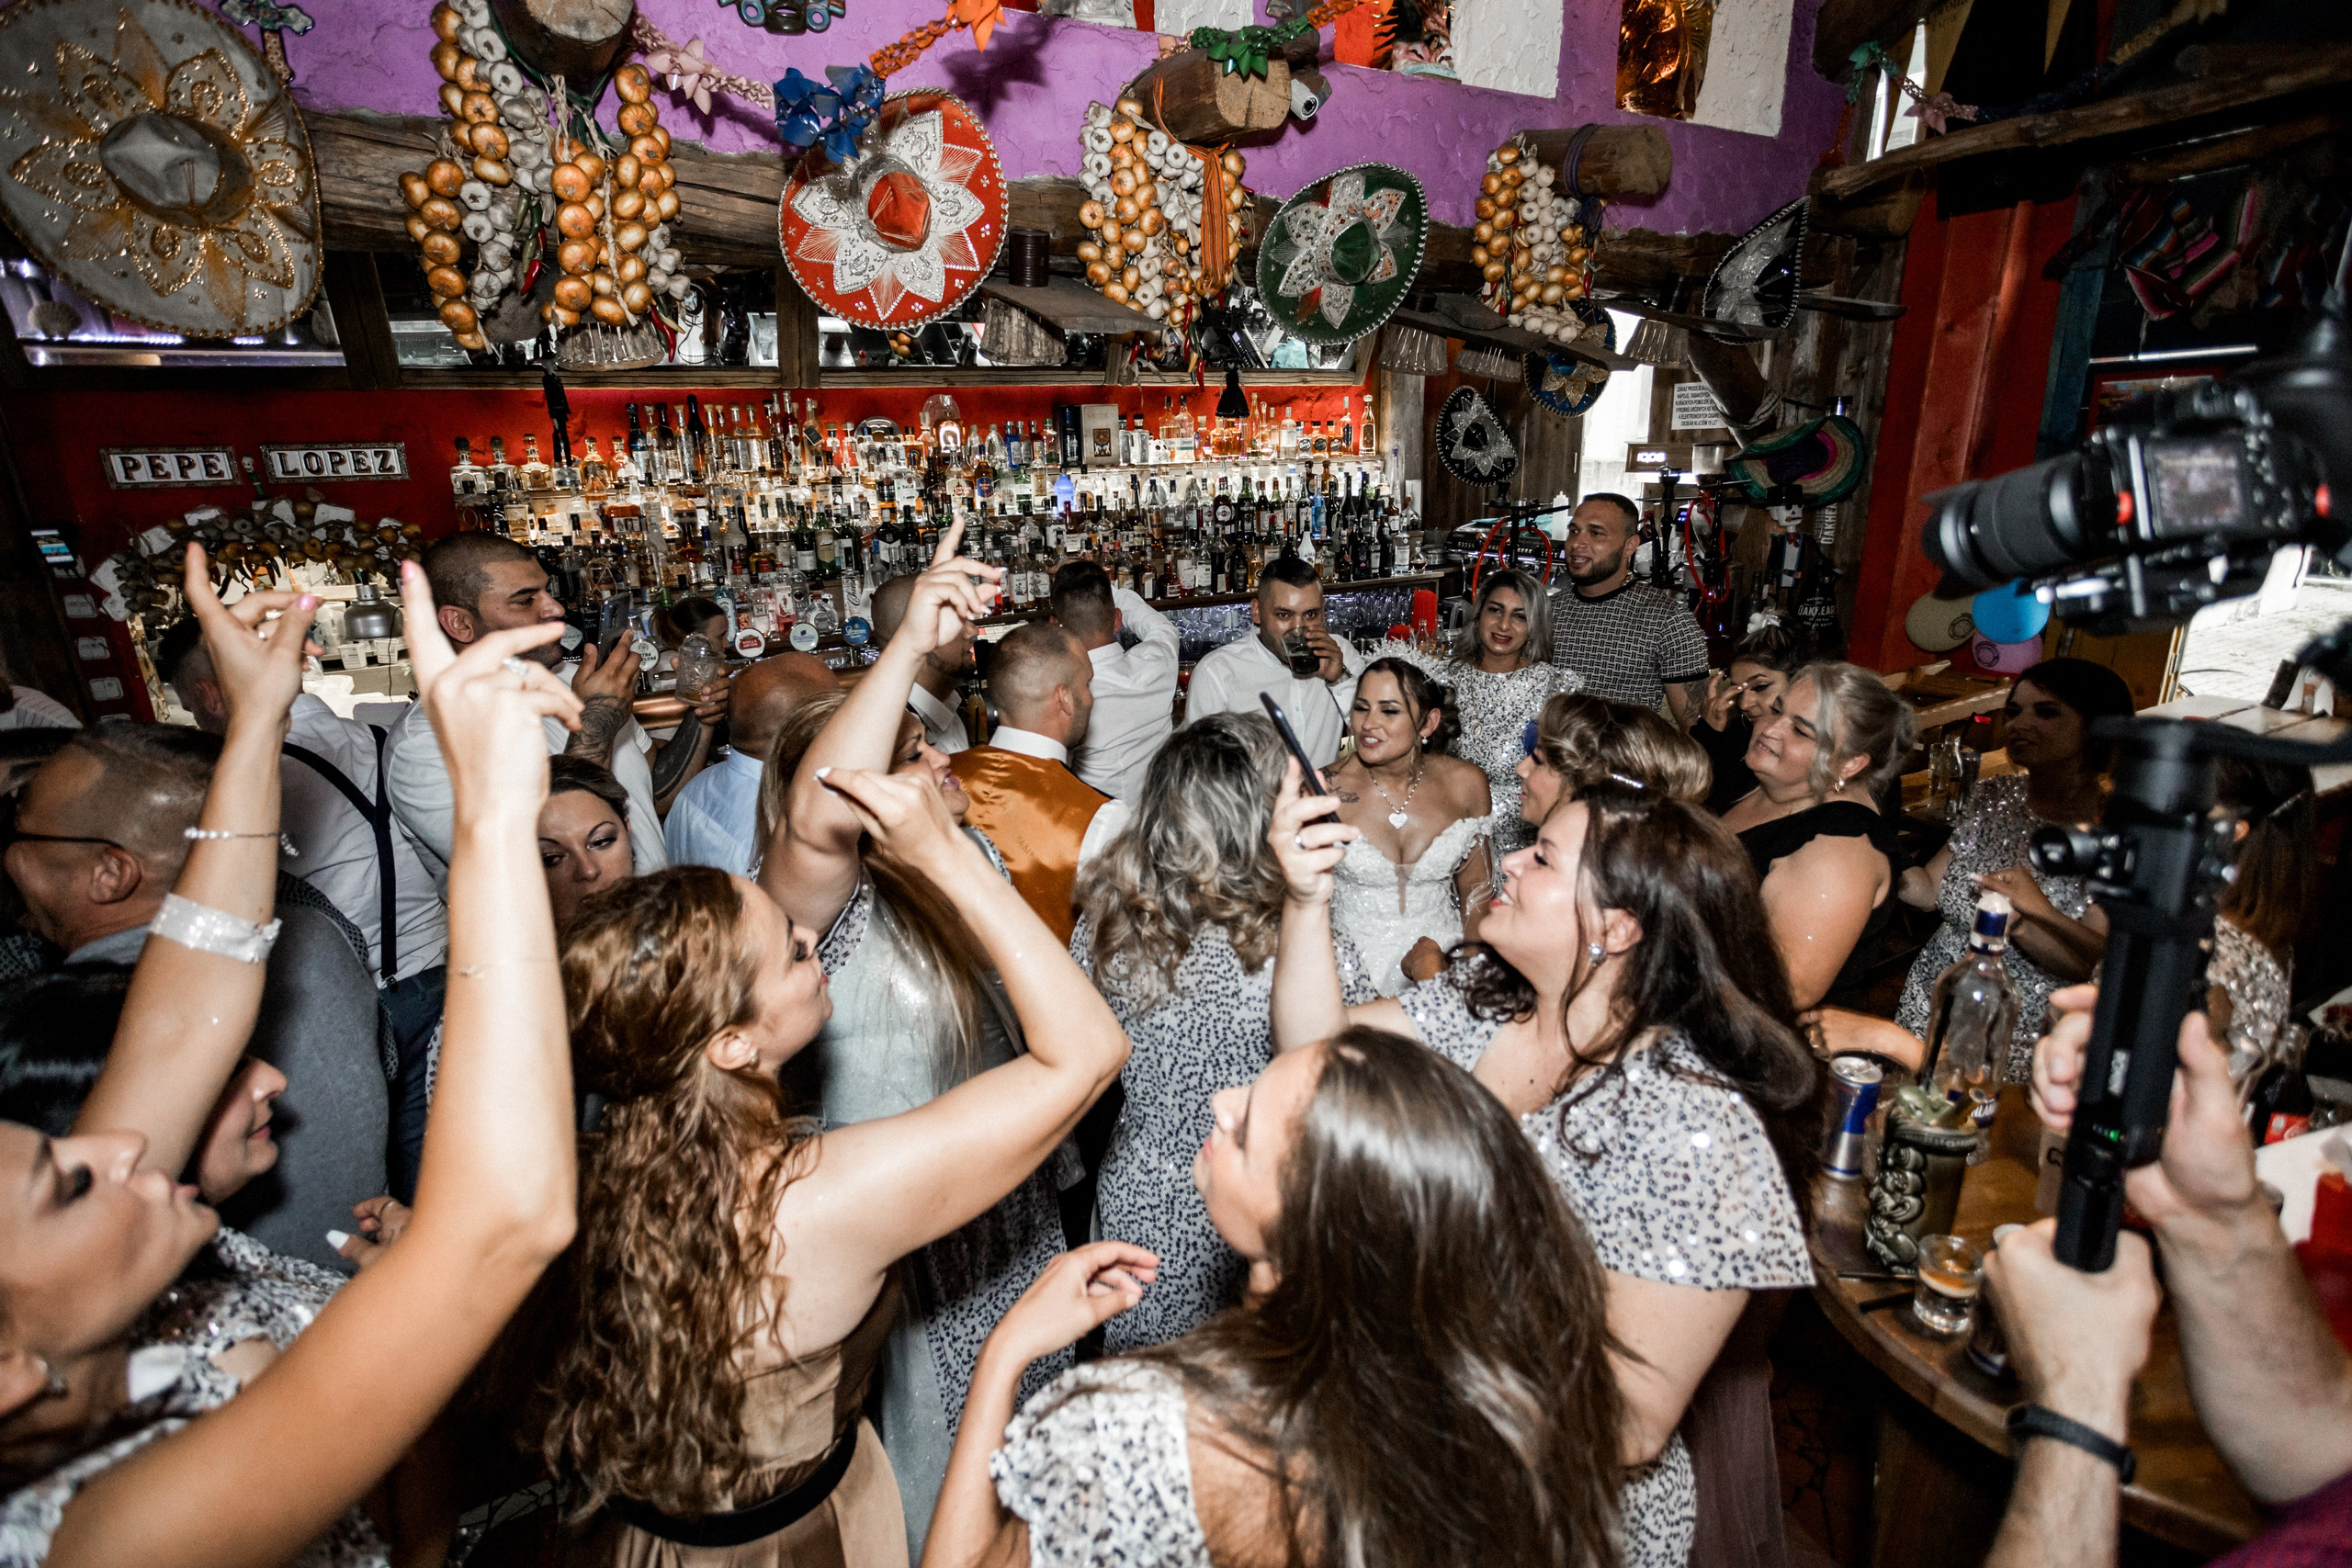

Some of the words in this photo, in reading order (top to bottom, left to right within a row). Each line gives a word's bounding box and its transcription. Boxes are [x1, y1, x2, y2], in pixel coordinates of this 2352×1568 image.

[119, 454, 226, 481] PEPE
[277, 449, 395, 475] LOPEZ
[1820, 502, 1837, 545] OAKHEA
